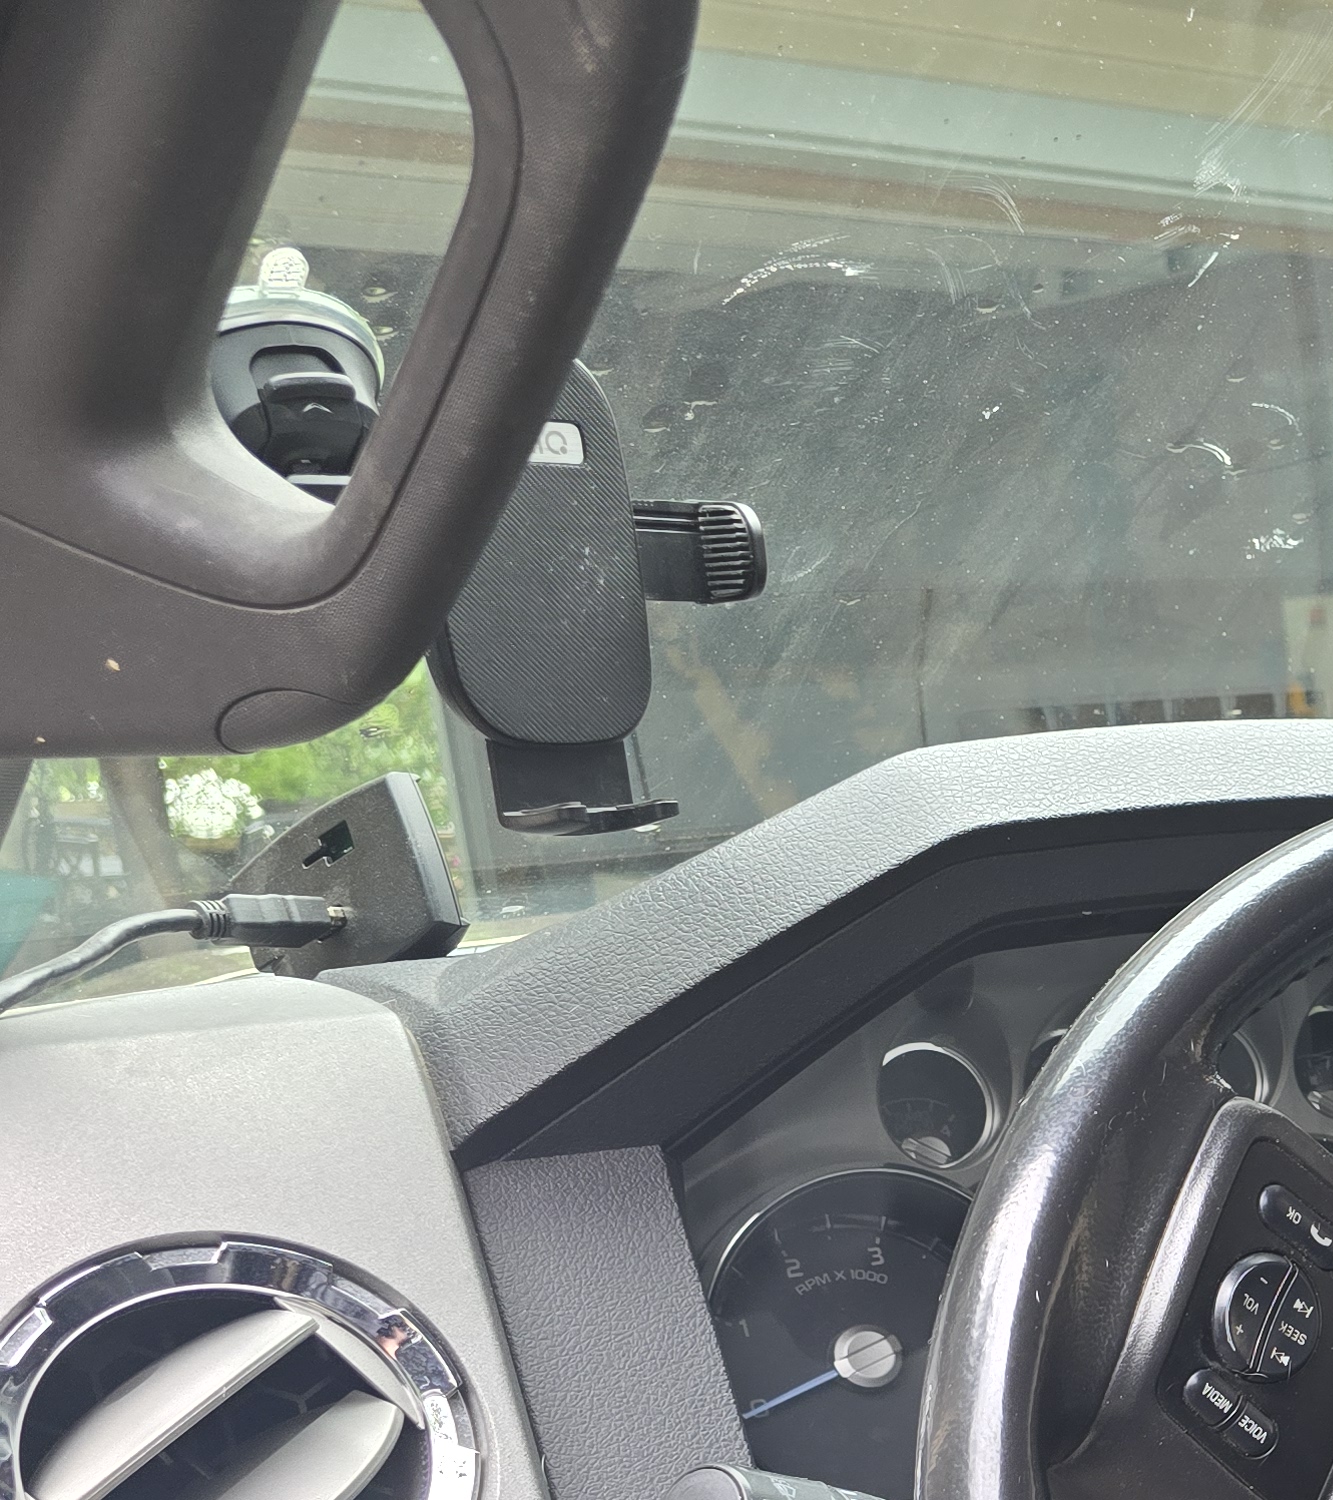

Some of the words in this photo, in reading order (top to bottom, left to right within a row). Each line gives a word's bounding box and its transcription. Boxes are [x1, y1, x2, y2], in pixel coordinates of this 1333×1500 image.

[1286, 1206, 1302, 1224] OK
[867, 1247, 885, 1266] 3
[785, 1258, 804, 1278] 2
[795, 1273, 831, 1295] RPM
[834, 1270, 847, 1281] X
[850, 1269, 888, 1284] 1000
[1243, 1293, 1260, 1315] VOL
[739, 1319, 750, 1337] 1
[1278, 1321, 1308, 1346] SEEK
[1202, 1382, 1233, 1413] MEDIA
[1238, 1415, 1267, 1444] VOICE
